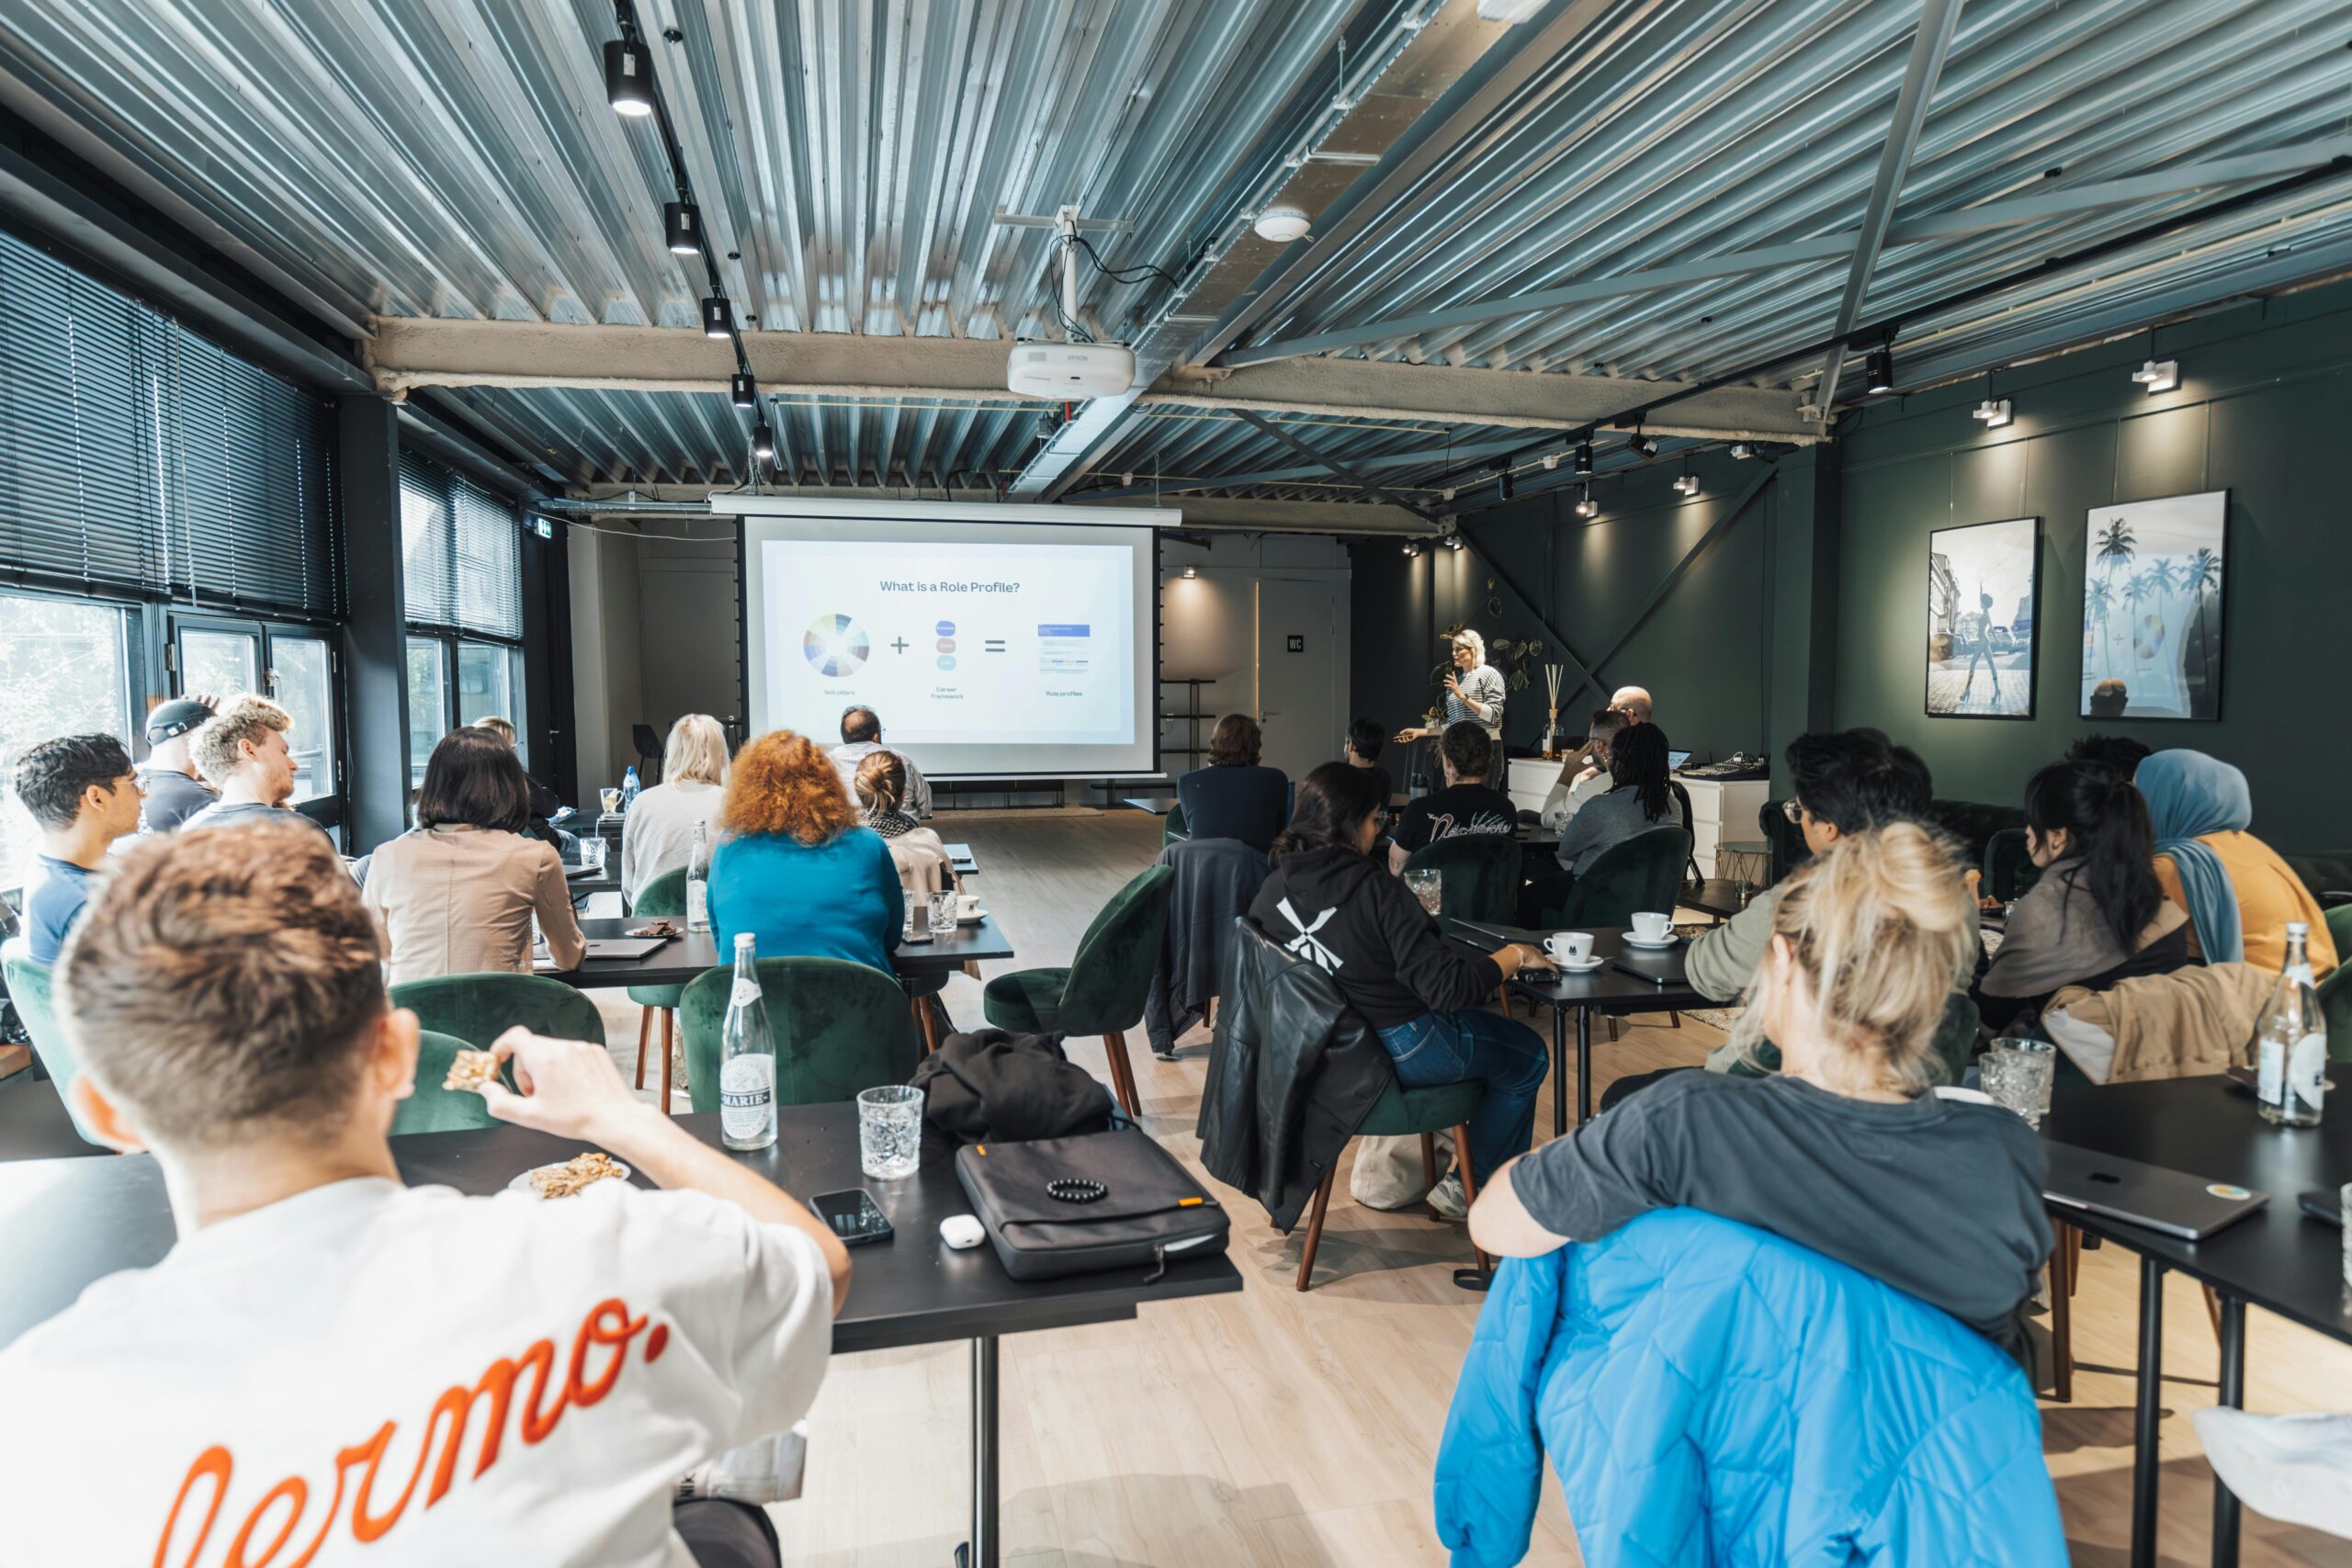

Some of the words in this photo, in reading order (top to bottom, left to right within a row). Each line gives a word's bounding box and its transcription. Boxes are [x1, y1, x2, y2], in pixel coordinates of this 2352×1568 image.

[880, 581, 915, 592] What
[917, 581, 927, 592] is
[930, 583, 938, 592] a
[940, 581, 968, 592] Role
[971, 582, 1021, 593] Profile?
[1289, 638, 1302, 649] WC
[1059, 690, 1083, 698] profiles
